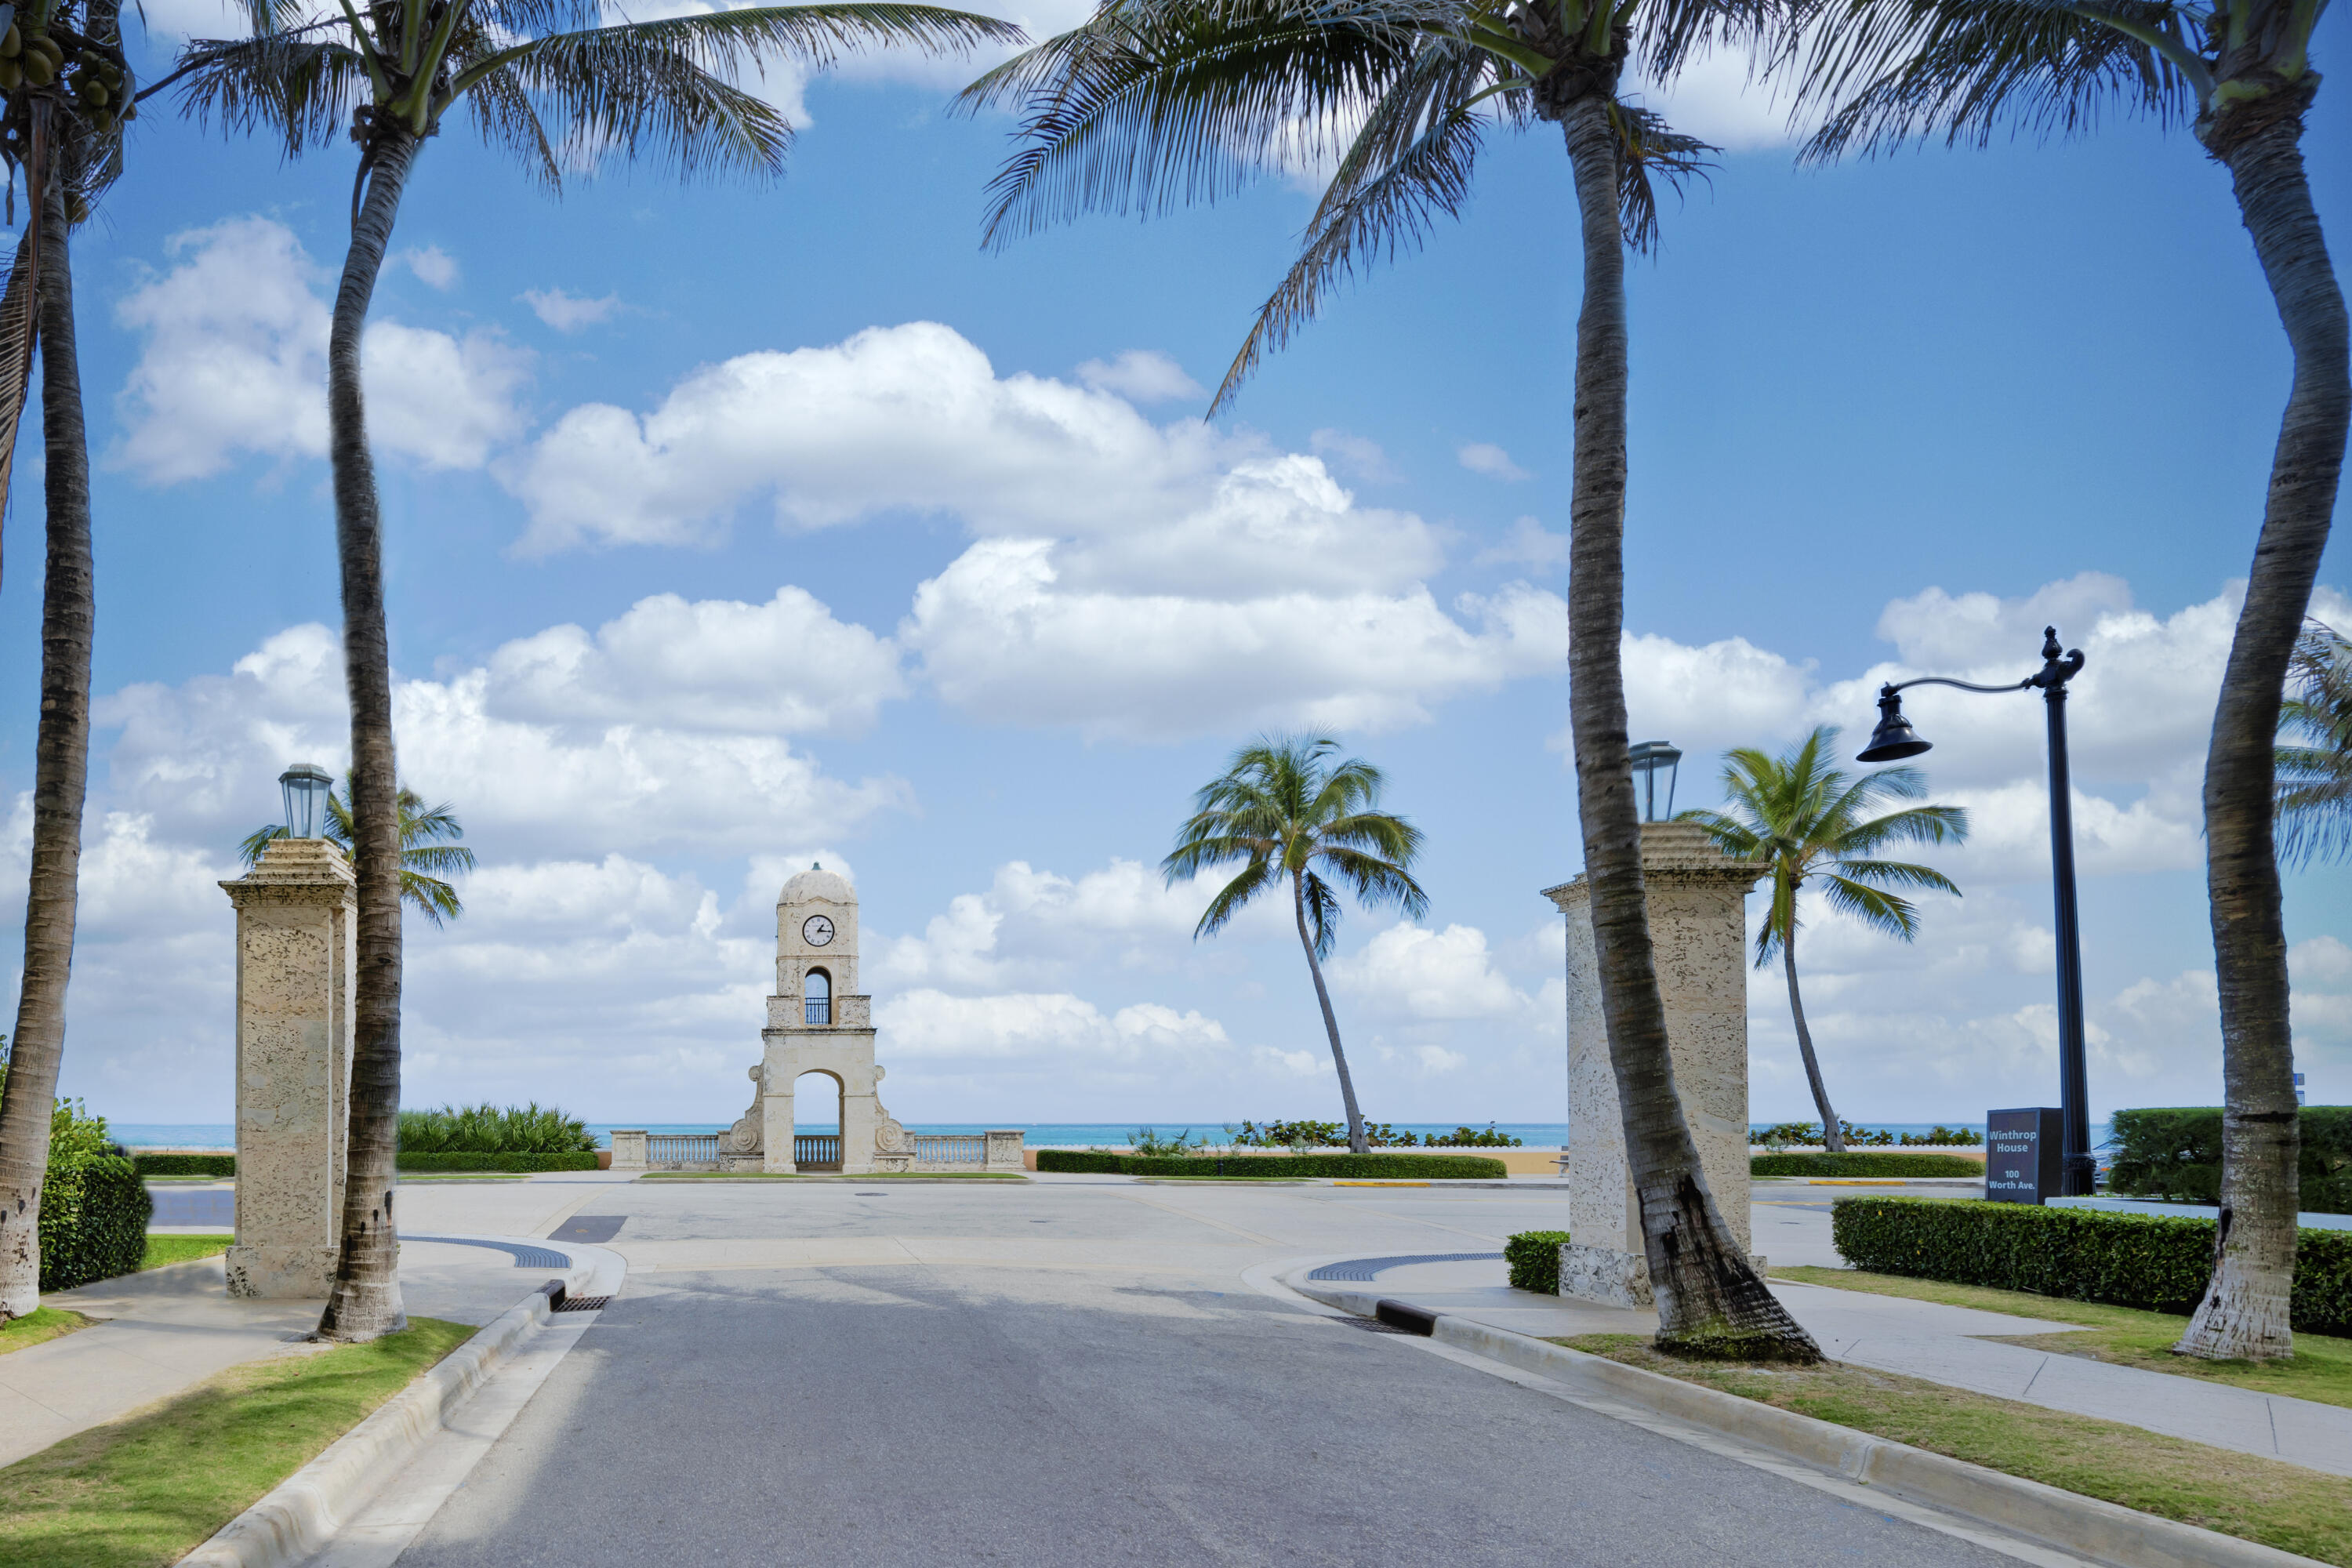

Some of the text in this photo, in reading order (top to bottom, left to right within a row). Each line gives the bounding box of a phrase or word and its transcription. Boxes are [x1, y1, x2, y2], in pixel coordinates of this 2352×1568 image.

[1990, 1130, 2037, 1142] Winthrop
[1997, 1143, 2028, 1152] House
[1989, 1181, 2016, 1189] Worth
